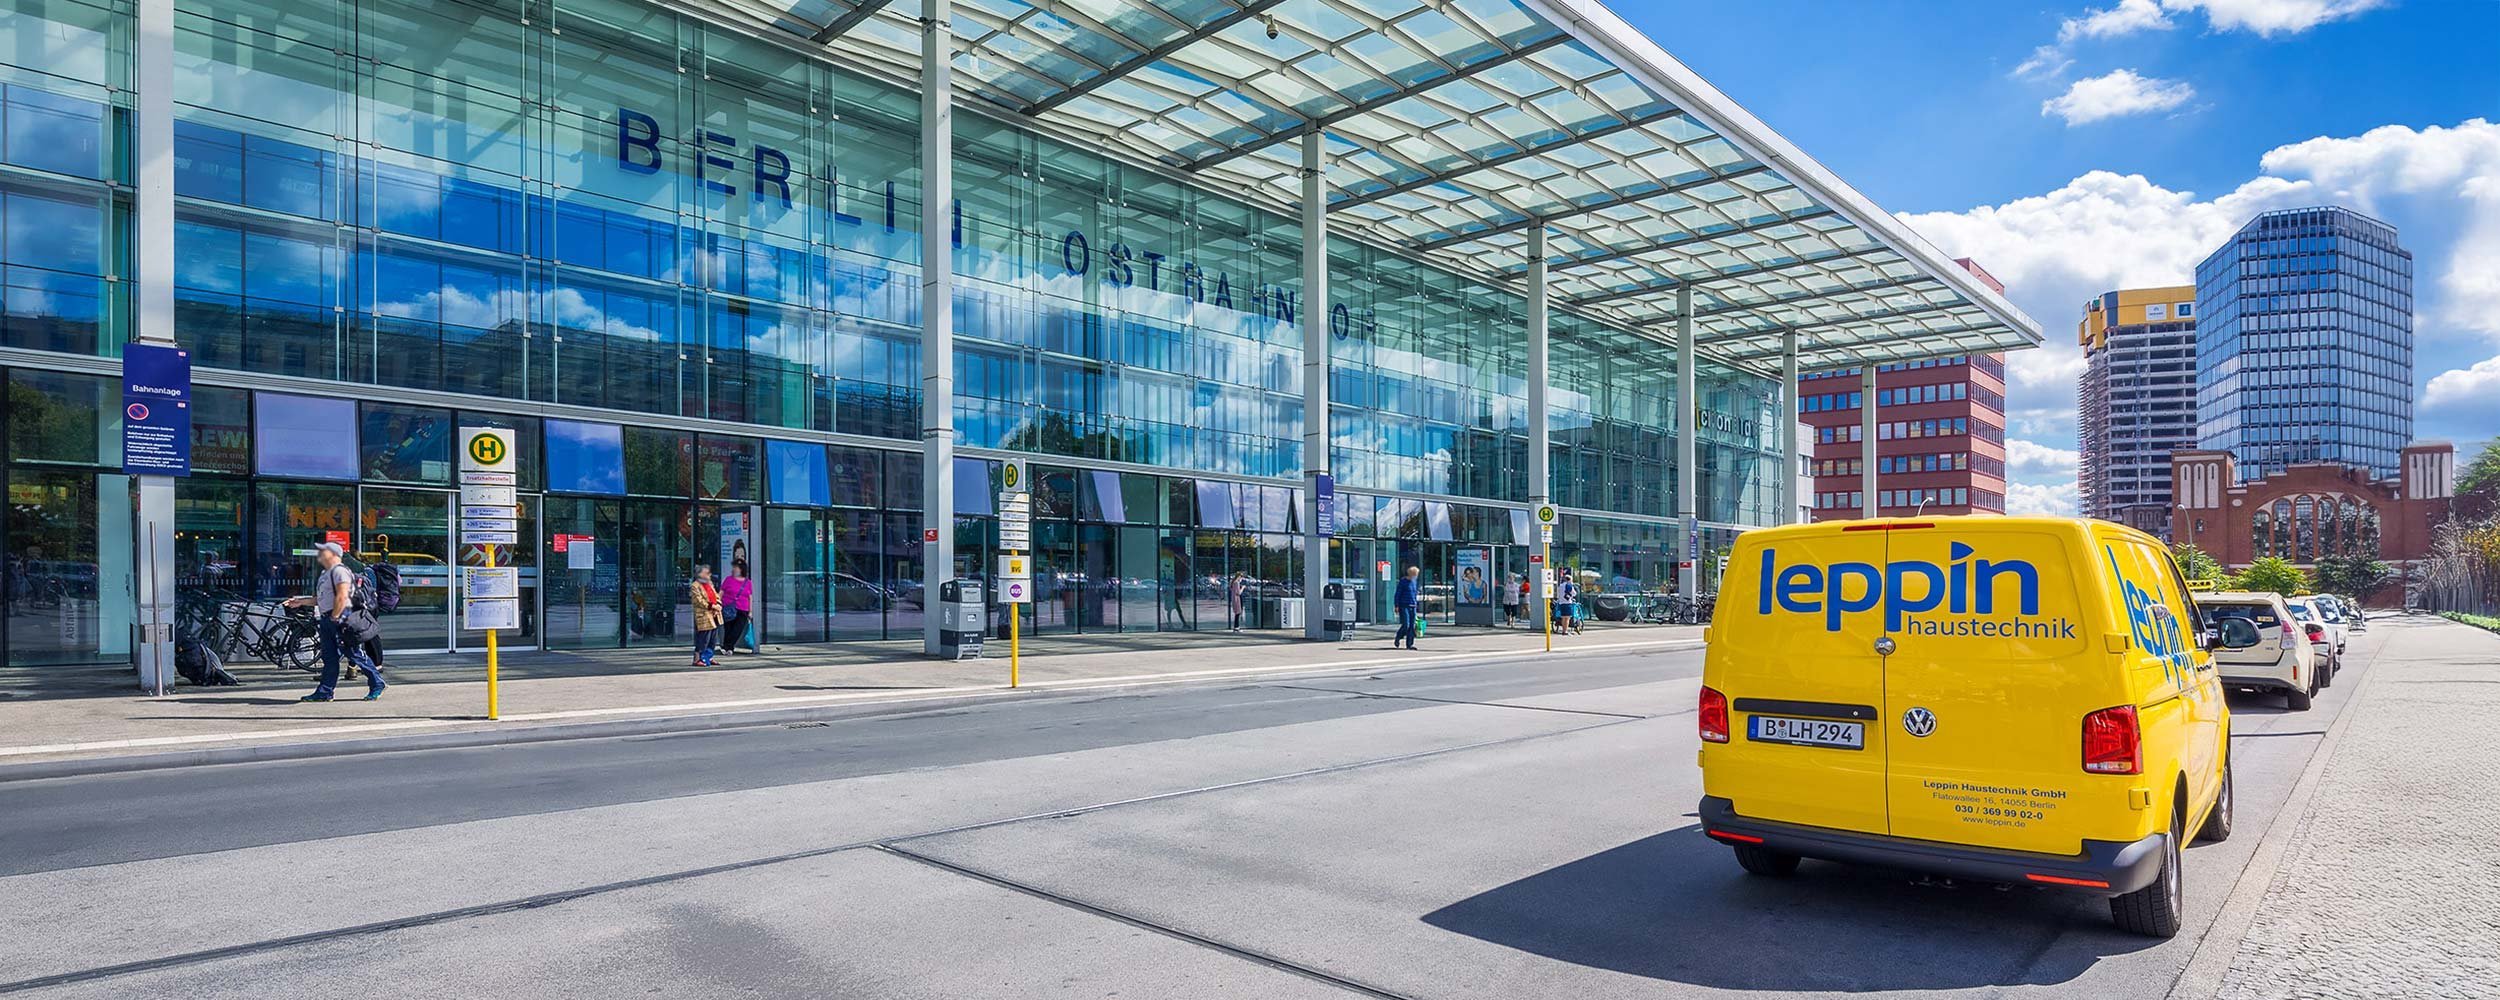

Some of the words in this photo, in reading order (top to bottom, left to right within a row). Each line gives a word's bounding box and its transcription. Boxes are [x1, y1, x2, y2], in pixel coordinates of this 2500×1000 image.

[617, 107, 962, 250] BERLI
[132, 384, 181, 396] Bahnanlage
[191, 429, 247, 448] REW
[479, 440, 496, 458] H
[1757, 541, 2038, 631] leppin
[1908, 615, 2076, 639] haustechnik
[1765, 719, 1777, 736] B
[1789, 721, 1813, 740] LH
[1816, 723, 1853, 742] 294
[1923, 779, 1959, 791] Leppin
[1961, 783, 2028, 796] Haustechnik
[2031, 788, 2066, 799] GmbH
[1932, 791, 1981, 803] Flatowallee
[2000, 798, 2027, 808] 14055
[2030, 800, 2056, 809] Berlin
[1955, 804, 1974, 814] 030
[1983, 807, 2001, 816] 369
[2004, 809, 2017, 818] 99
[2020, 810, 2044, 820] 02-0
[1962, 815, 2026, 827] www.leppin.de
